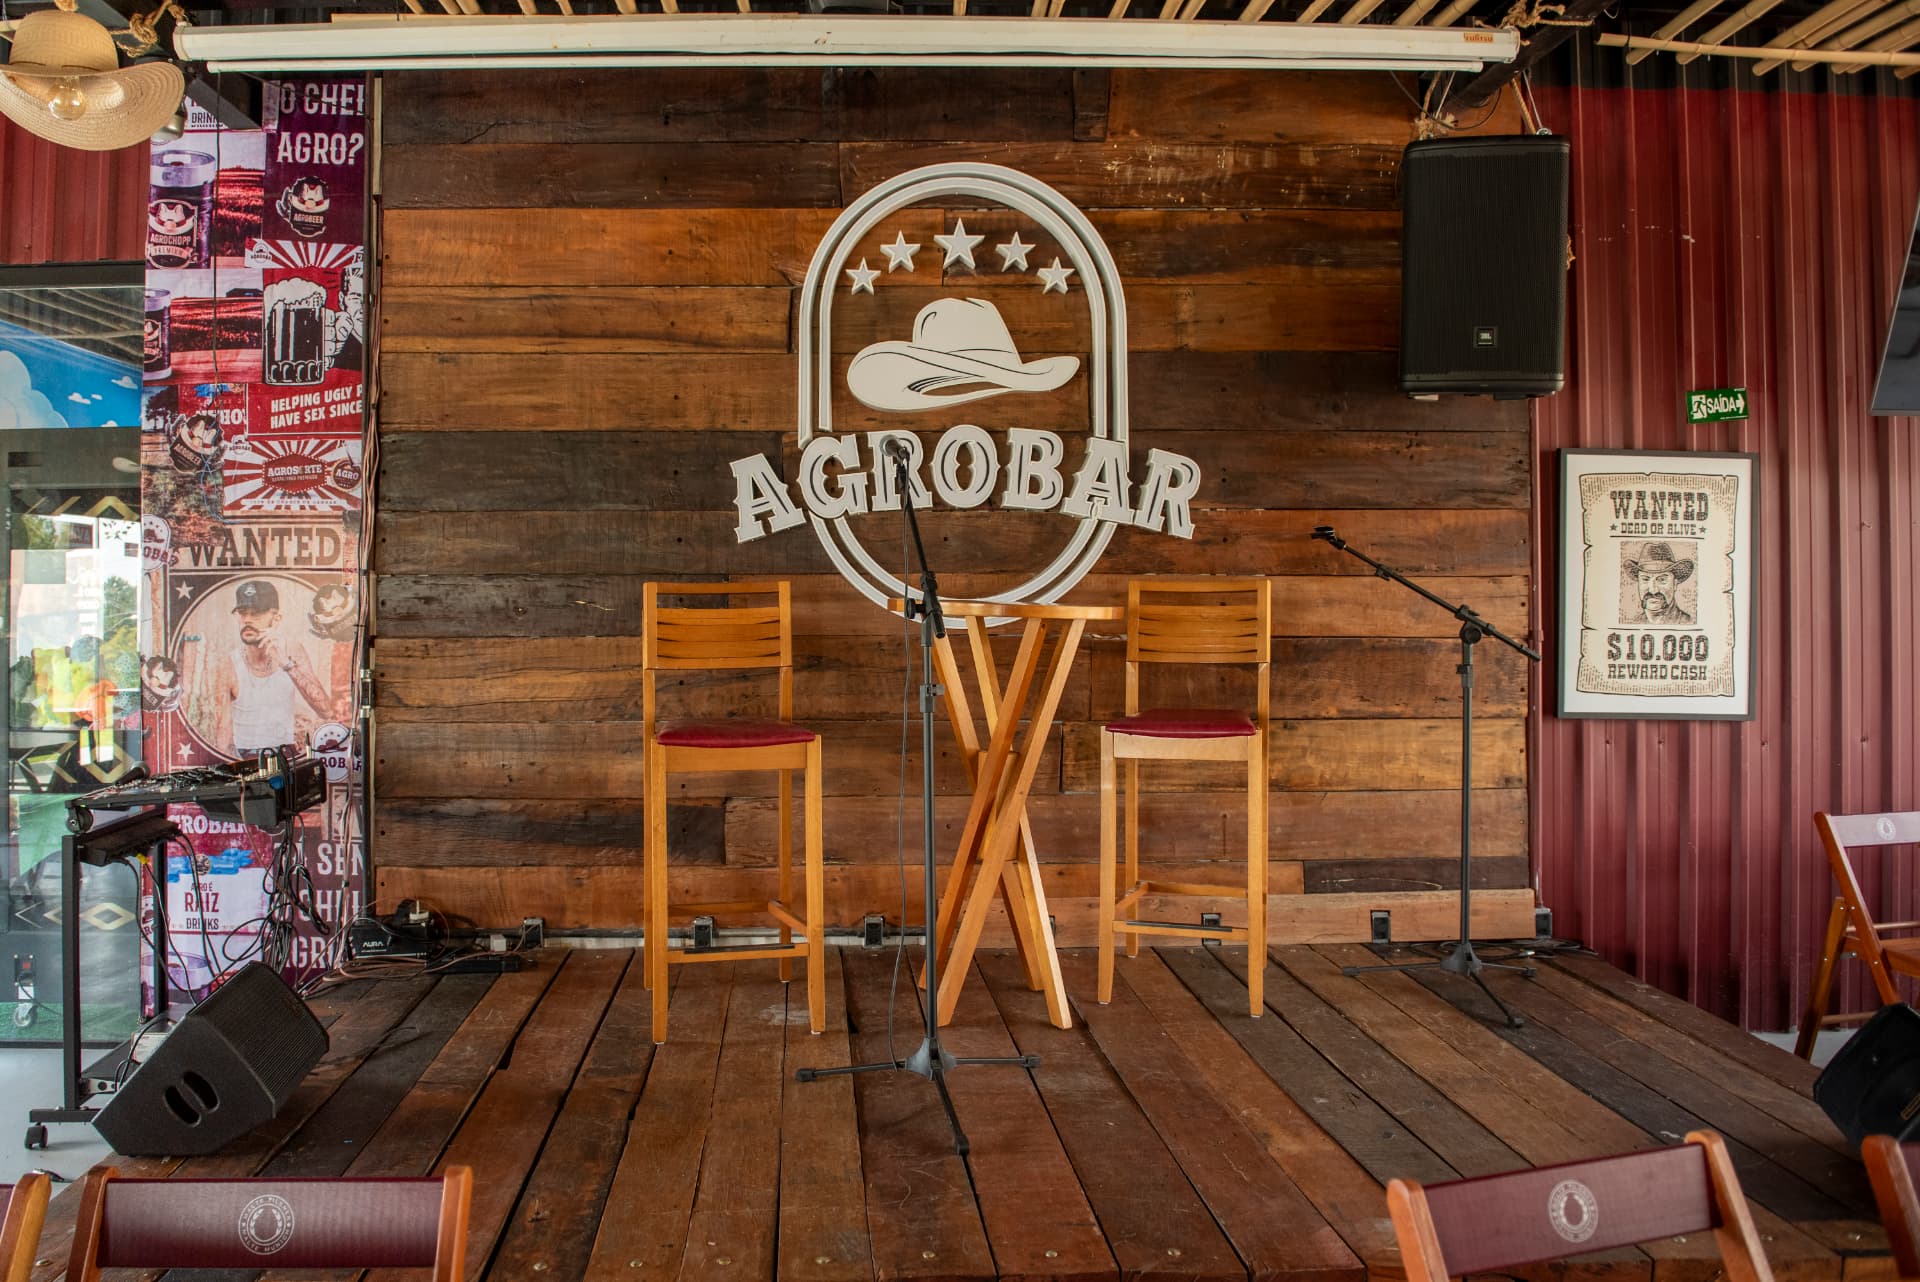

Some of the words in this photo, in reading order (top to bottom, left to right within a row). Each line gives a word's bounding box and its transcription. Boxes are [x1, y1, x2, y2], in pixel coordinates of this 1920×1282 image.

[276, 131, 364, 166] AGRO?
[271, 392, 320, 413] HELPING
[324, 386, 352, 403] UGLY
[1707, 393, 1737, 414] SAÍDA
[270, 412, 300, 430] HAVE
[304, 406, 326, 424] SEX
[329, 400, 363, 418] SINCE
[335, 468, 360, 481] AGRO
[729, 424, 1201, 544] AGROBAR
[1610, 490, 1709, 521] WANTED
[1621, 522, 1648, 535] DEAD
[1650, 522, 1664, 535] OR
[1667, 523, 1697, 536] ALIVE
[190, 527, 341, 568] WANTED
[1607, 632, 1709, 662] $10.000
[1607, 663, 1668, 680] REWARD
[1670, 664, 1708, 681] CASH
